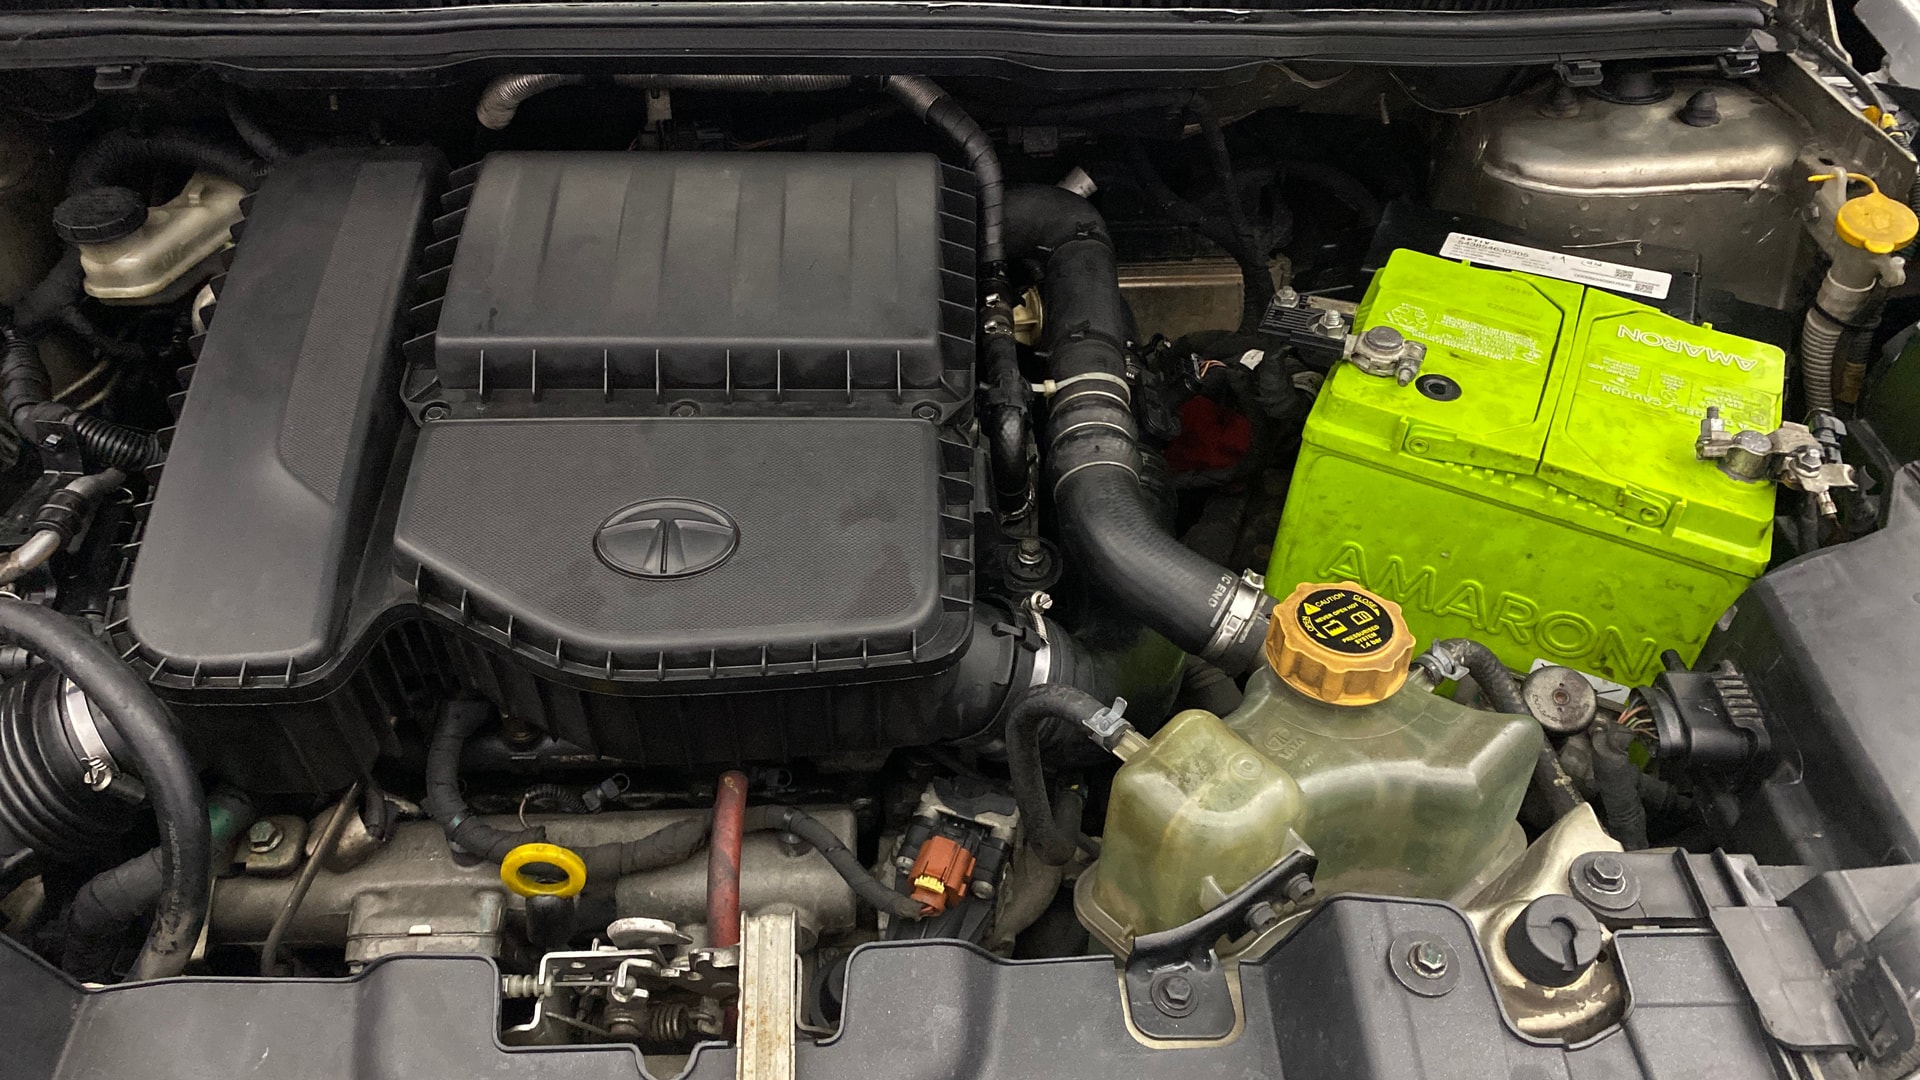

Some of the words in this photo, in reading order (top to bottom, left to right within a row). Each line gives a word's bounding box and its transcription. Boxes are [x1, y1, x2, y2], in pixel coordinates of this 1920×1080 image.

[1617, 324, 1758, 371] AMARON
[1602, 384, 1663, 407] CAUTION
[1675, 405, 1734, 426] DGER
[1207, 582, 1227, 608] END
[1315, 592, 1346, 607] CAUTION
[1353, 594, 1378, 609] CLOSE
[1314, 613, 1334, 623] NEVER
[1332, 606, 1348, 616] OPEN
[1347, 602, 1359, 611] HOT
[1317, 541, 1658, 682] AMARON
[1354, 631, 1378, 645] SYSTEM
[1360, 641, 1372, 649] 1.4
[1370, 637, 1383, 645] bar
